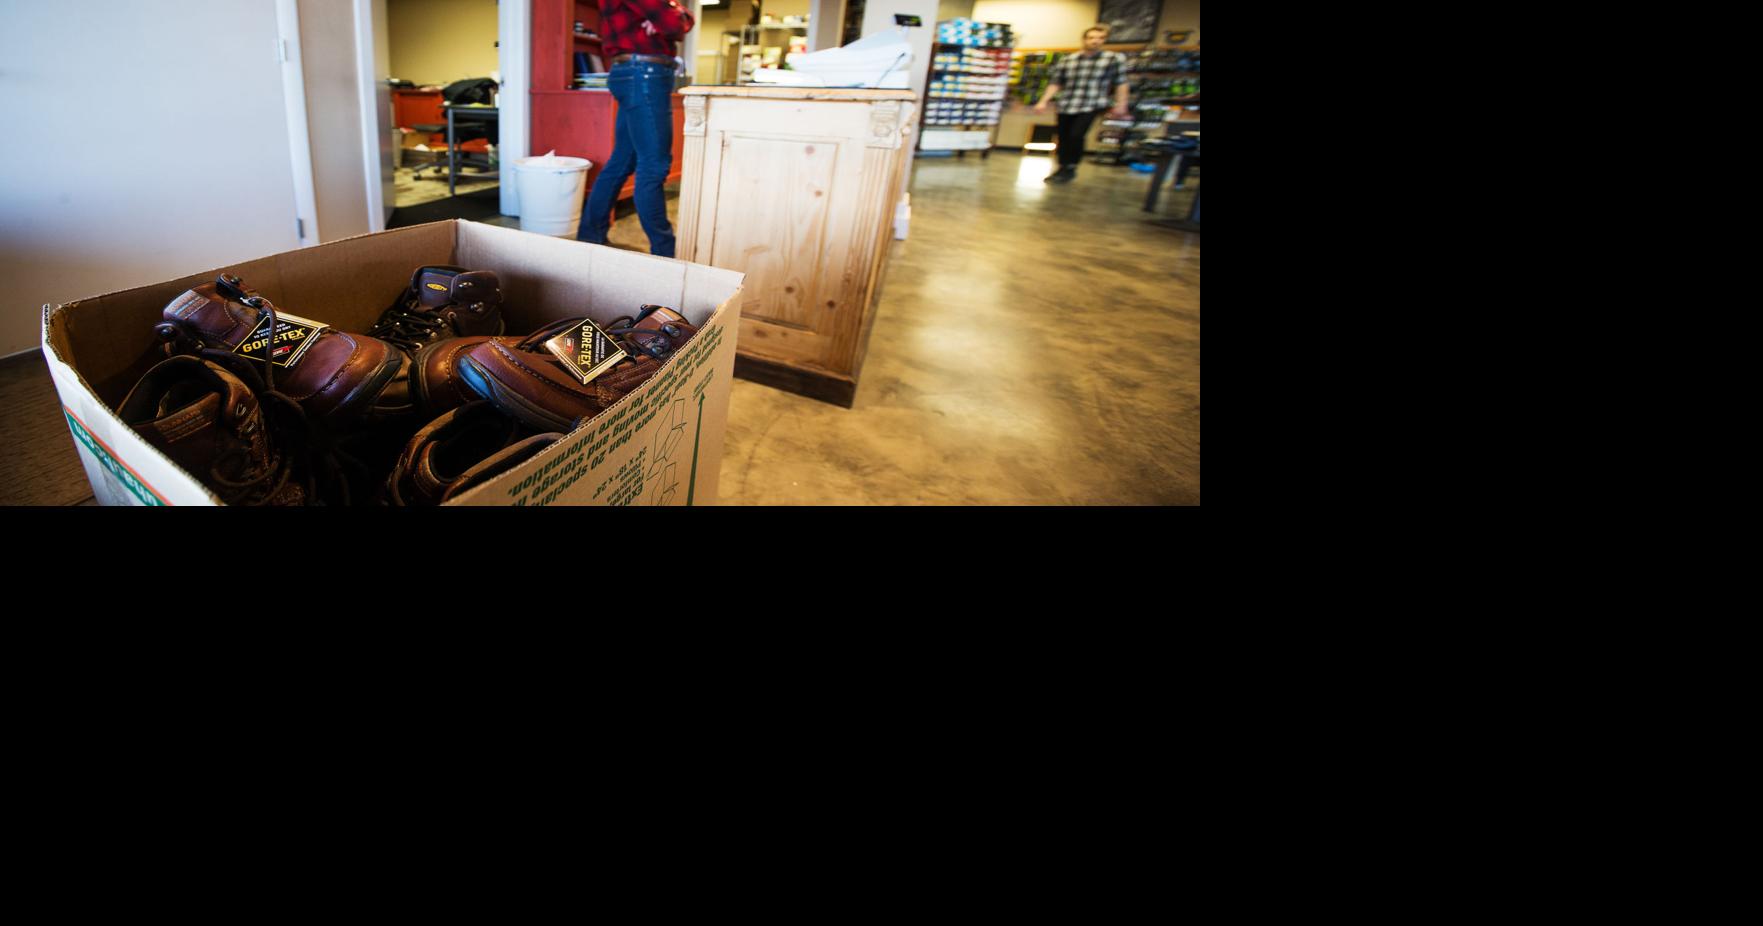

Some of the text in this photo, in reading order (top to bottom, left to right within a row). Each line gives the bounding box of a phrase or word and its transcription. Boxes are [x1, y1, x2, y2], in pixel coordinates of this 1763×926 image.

[242, 328, 306, 353] GORE-TEX
[581, 325, 593, 365] GORE-TEX
[628, 395, 644, 413] for
[659, 392, 672, 411] has
[599, 407, 627, 435] more
[613, 402, 649, 438] moving
[635, 408, 657, 433] more
[587, 434, 609, 460] and
[609, 429, 632, 455] than
[508, 430, 595, 497] information.
[591, 450, 606, 470] 20
[532, 453, 584, 498] storage
